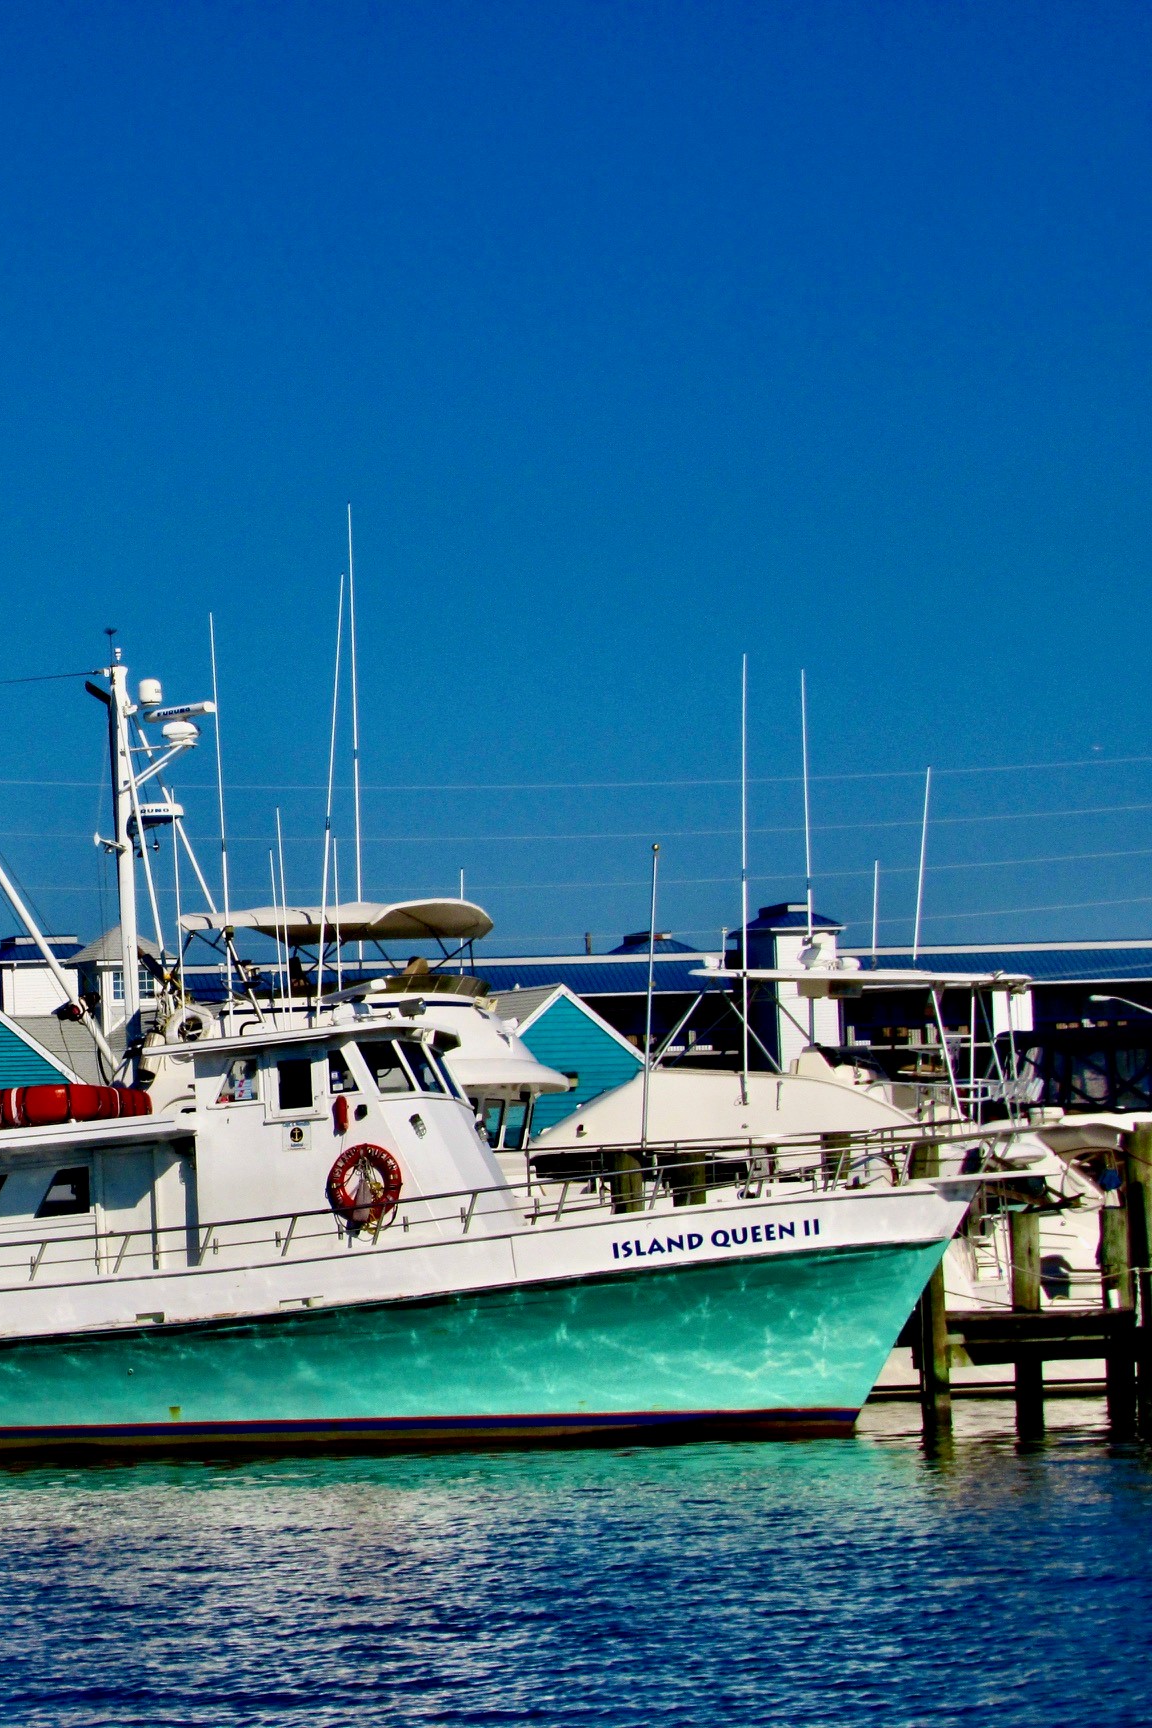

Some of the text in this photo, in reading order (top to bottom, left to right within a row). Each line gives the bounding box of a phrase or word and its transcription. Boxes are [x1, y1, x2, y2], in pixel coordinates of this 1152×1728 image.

[157, 707, 191, 717] FURUNO
[612, 1218, 821, 1259] ISLAND QUEEN II
